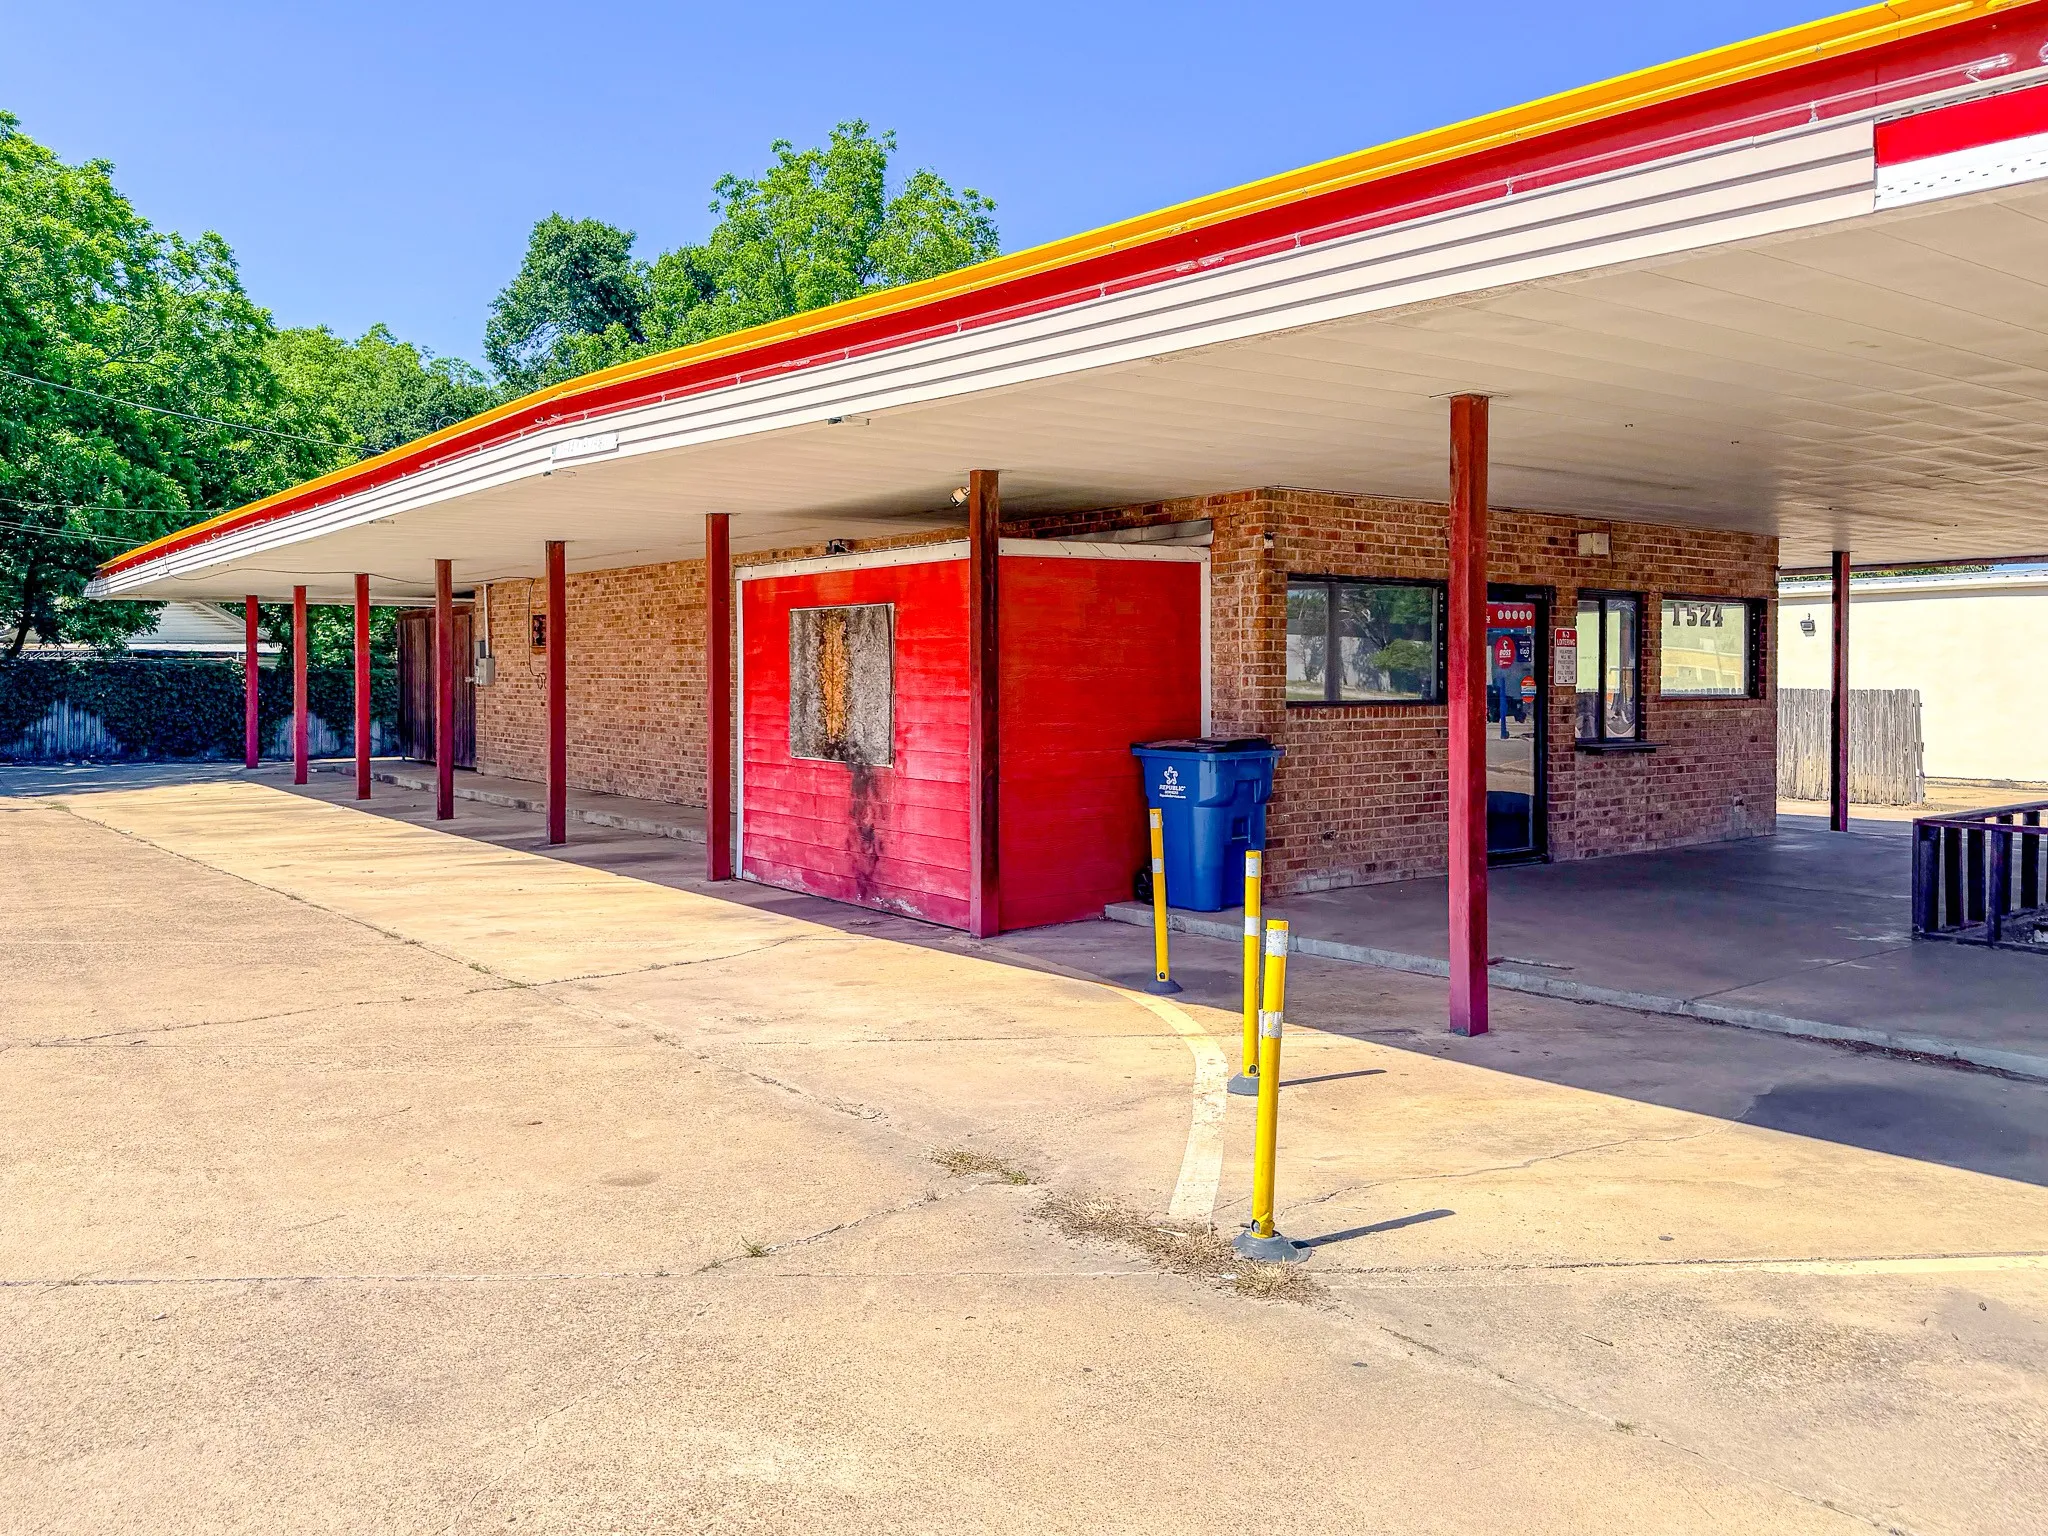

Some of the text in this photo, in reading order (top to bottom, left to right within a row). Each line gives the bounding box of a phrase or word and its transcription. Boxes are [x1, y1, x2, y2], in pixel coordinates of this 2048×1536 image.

[1673, 603, 1723, 627] 1524
[1557, 638, 1576, 646] LOITERING
[1159, 784, 1185, 792] REPUBLIC
